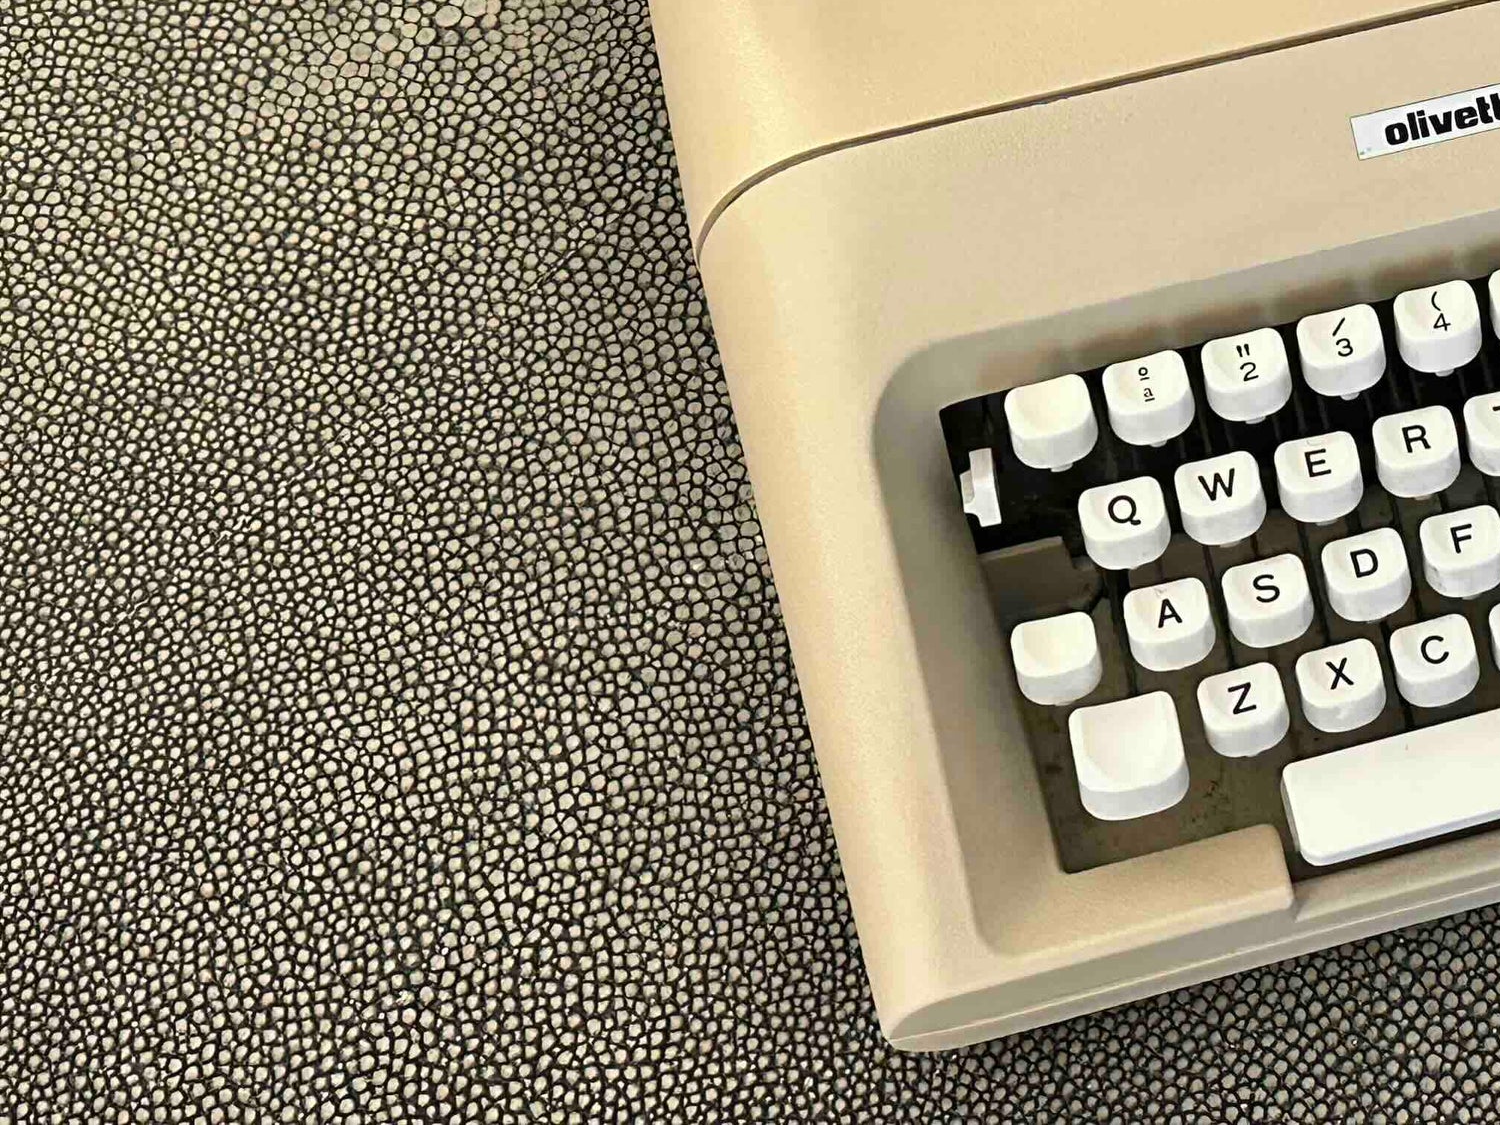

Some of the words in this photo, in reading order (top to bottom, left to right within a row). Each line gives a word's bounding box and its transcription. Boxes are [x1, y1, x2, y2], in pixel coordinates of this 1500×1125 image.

[1431, 291, 1443, 312] (
[1433, 311, 1451, 331] 4
[1336, 338, 1354, 357] 3
[1240, 362, 1258, 381] 2
[1402, 425, 1431, 453] R
[1305, 449, 1331, 477] E
[1198, 468, 1235, 501] W
[1108, 495, 1141, 525] Q
[1450, 524, 1472, 554] F
[1350, 549, 1378, 578] D
[1253, 574, 1280, 603] S
[1158, 599, 1182, 628] A
[1421, 636, 1449, 664] C
[1326, 658, 1354, 690] X
[1228, 682, 1256, 714] Z
